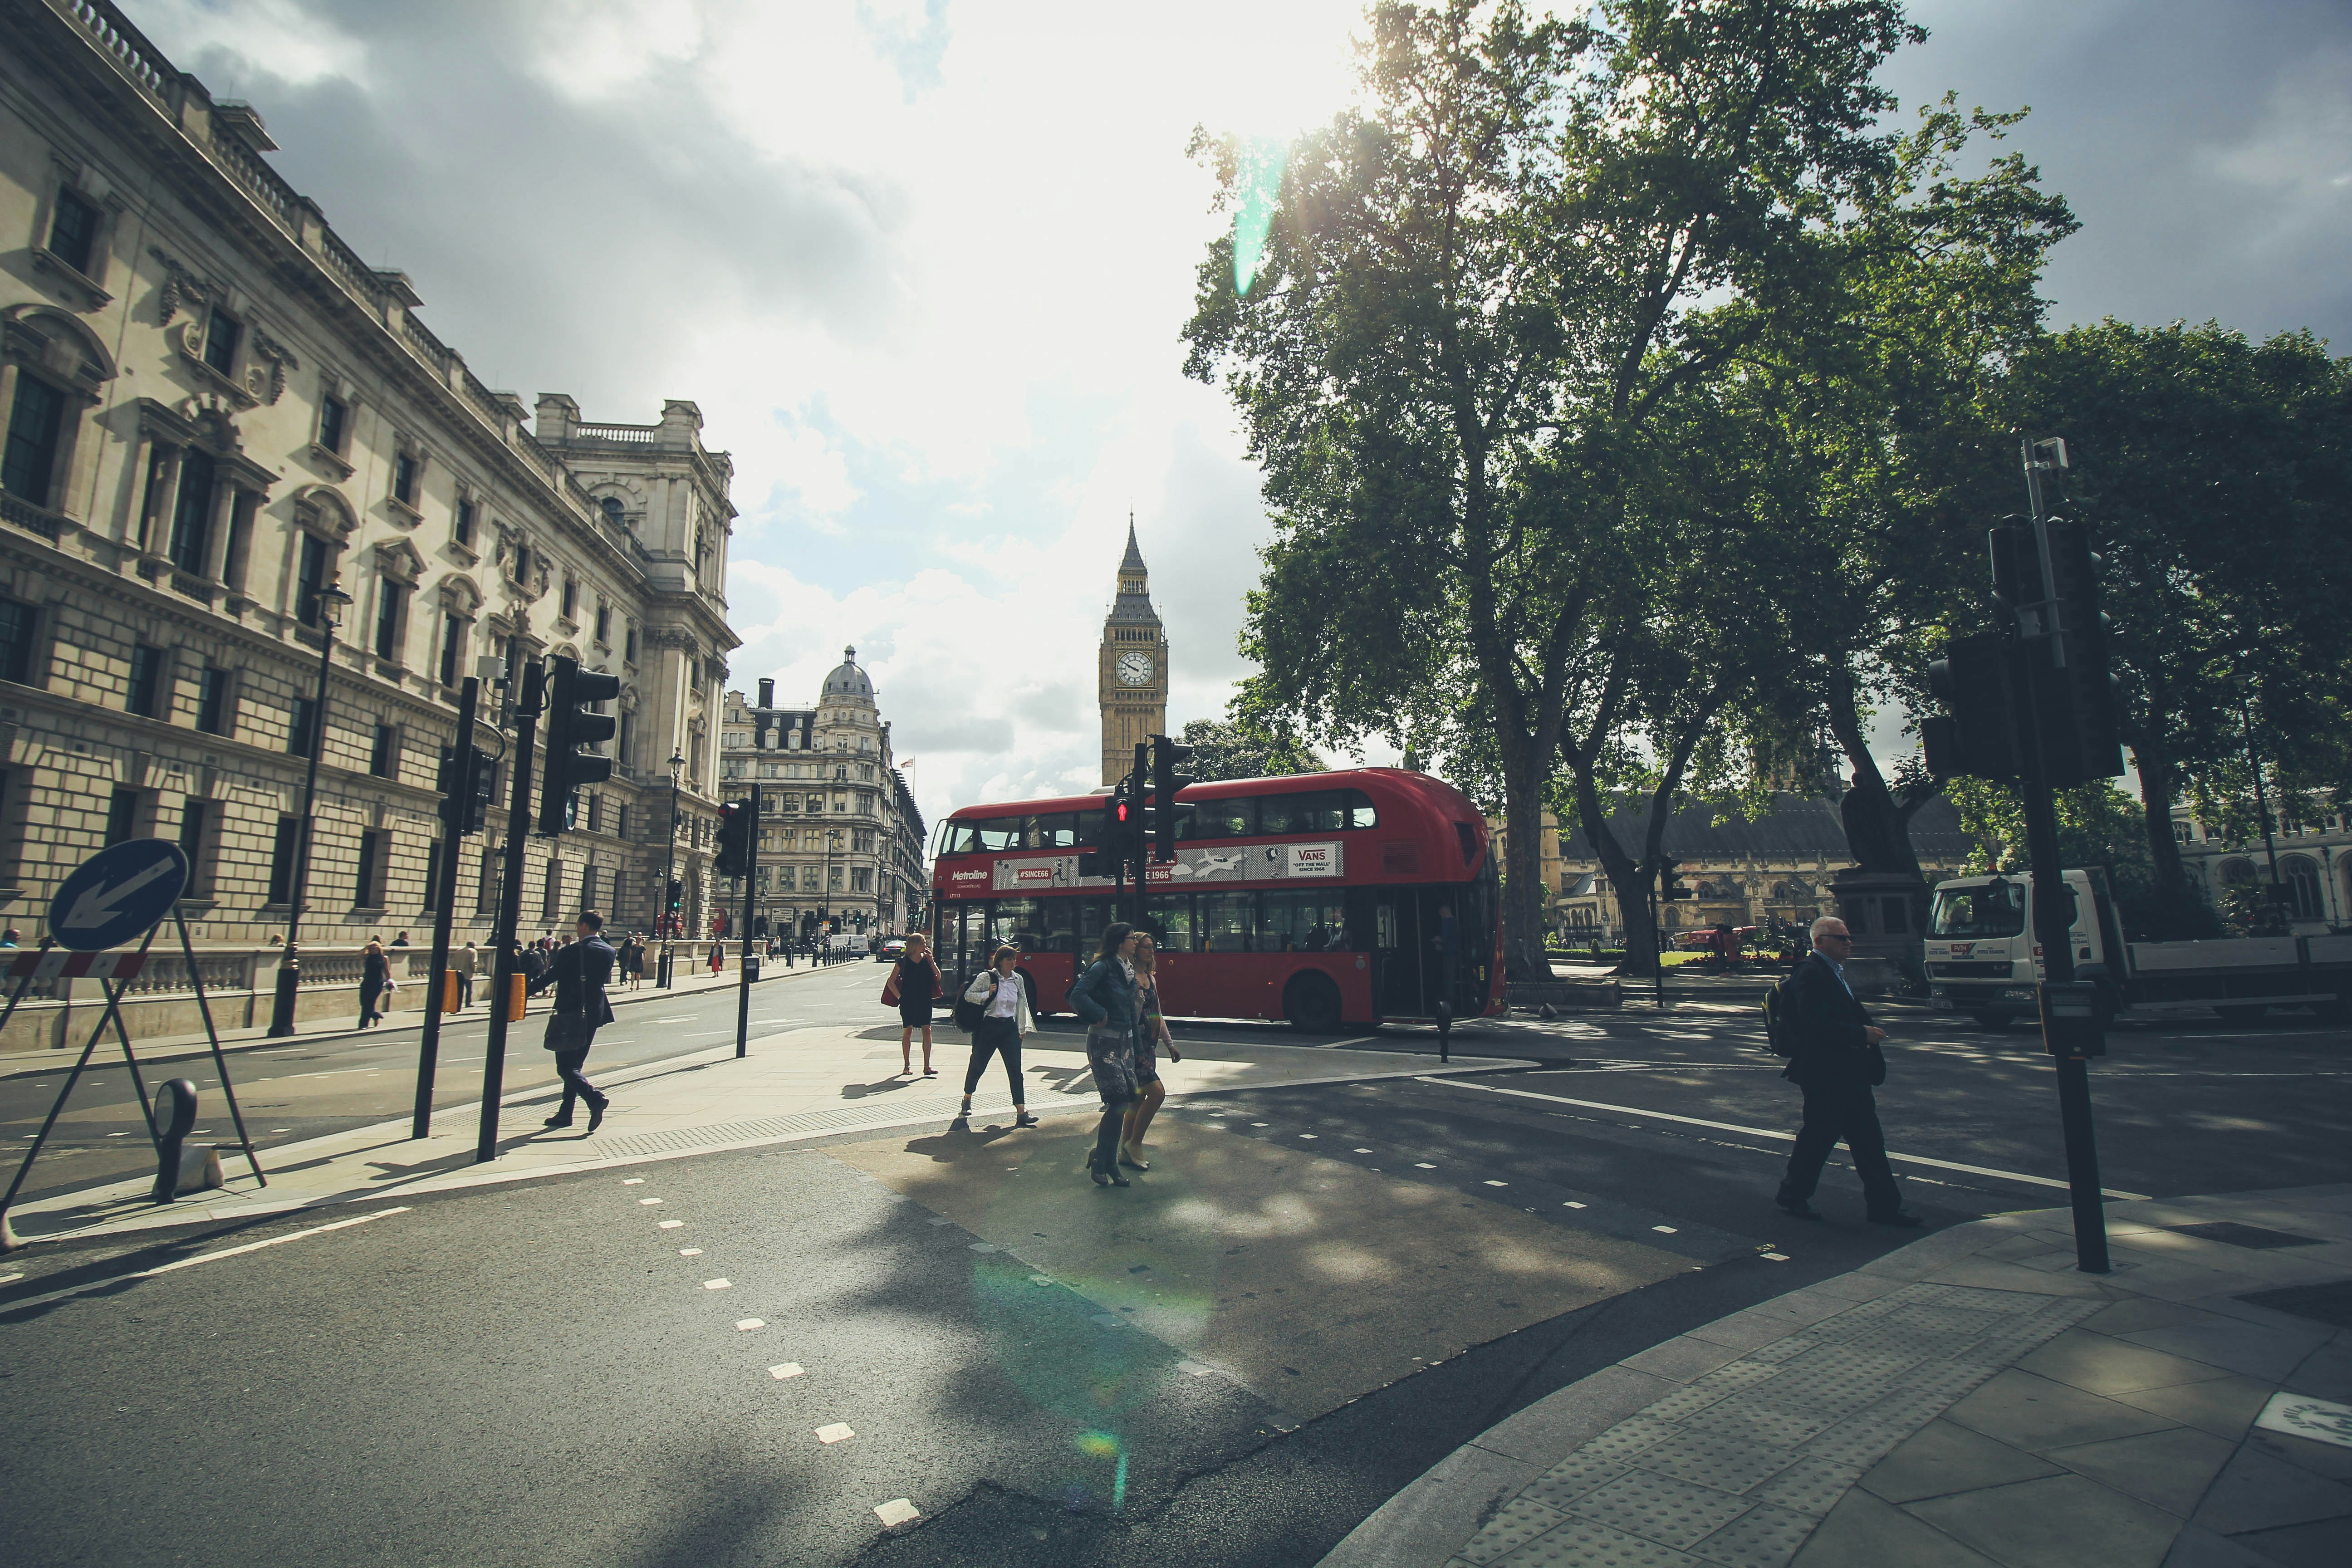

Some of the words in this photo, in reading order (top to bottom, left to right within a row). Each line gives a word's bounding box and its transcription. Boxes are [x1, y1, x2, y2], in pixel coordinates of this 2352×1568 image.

[1298, 849, 1326, 861] VANS
[952, 870, 987, 880] Metroline
[1152, 871, 1169, 879] 1966
